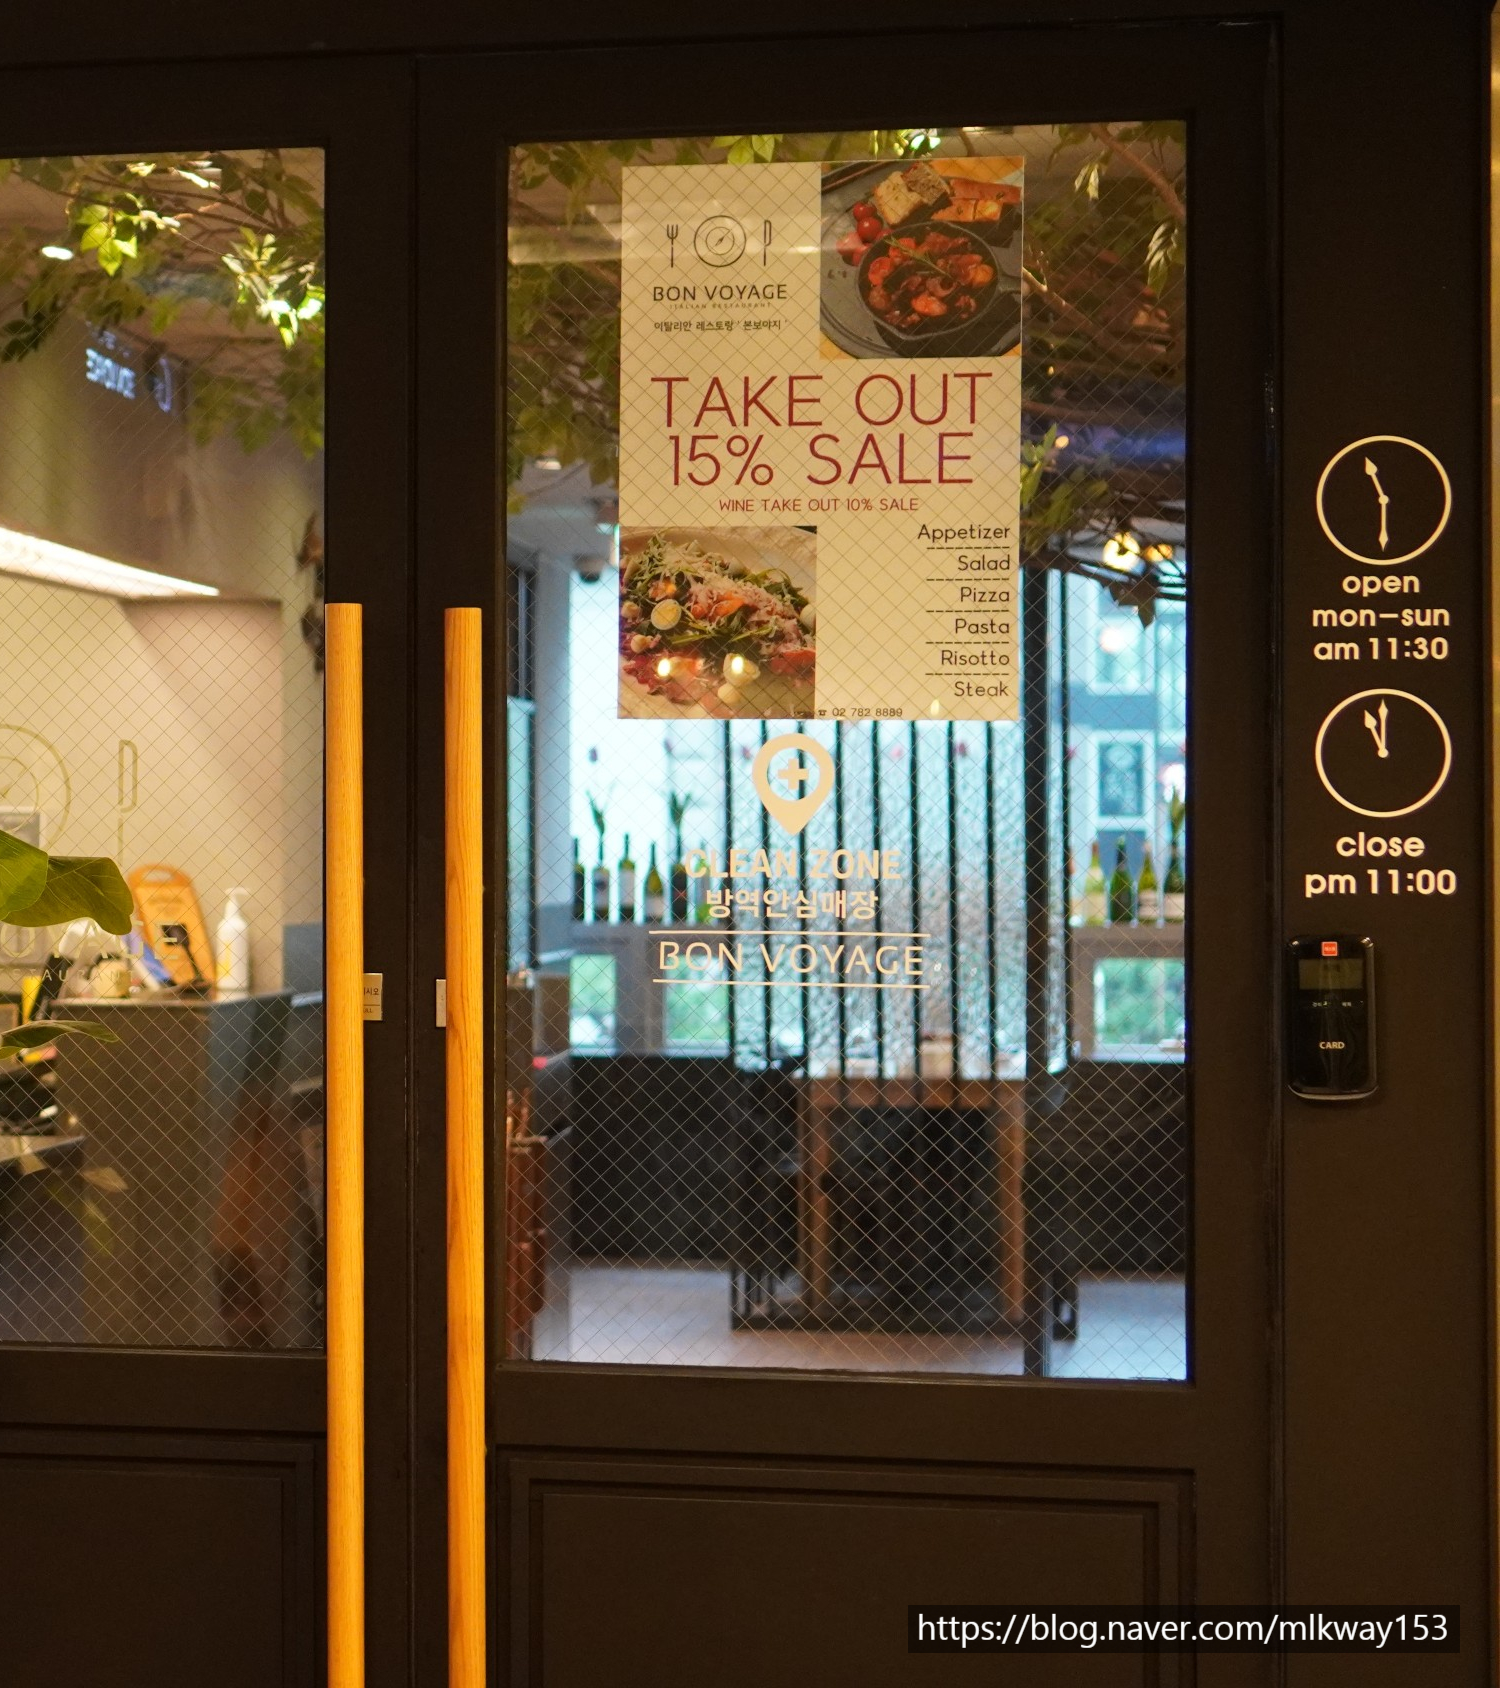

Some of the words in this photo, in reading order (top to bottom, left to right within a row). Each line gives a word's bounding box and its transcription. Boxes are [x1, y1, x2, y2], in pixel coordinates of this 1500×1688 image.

[653, 286, 696, 301] BON
[704, 284, 787, 300] VOYAGE
[654, 321, 692, 332] 이탈리안
[696, 320, 734, 332] 레스토랑
[651, 375, 823, 428] TAKE
[855, 373, 993, 426] OUT
[669, 434, 774, 486] 15%
[807, 432, 974, 486] SALE
[719, 498, 754, 512] WINE
[761, 498, 801, 512] TAKE
[808, 498, 840, 511] OUT
[846, 497, 873, 511] 10%
[879, 497, 919, 511] SALE
[917, 524, 1010, 544] Appetizer
[957, 555, 1010, 572] Salad
[960, 587, 1010, 603] Pizza
[1342, 574, 1420, 598] open
[954, 618, 1010, 635] Pasta
[941, 649, 1010, 666] Risotto
[1313, 640, 1360, 660] am
[1368, 637, 1449, 660] 11:30
[954, 681, 1009, 697] Steak
[832, 707, 846, 717] 02
[851, 707, 871, 717] 782
[1336, 832, 1425, 857] close
[684, 849, 797, 879] CLEAN
[808, 849, 901, 880] ZONE
[1305, 872, 1356, 898] pm
[1366, 869, 1457, 896] 11:00
[706, 889, 879, 919] 방역안심매장
[660, 941, 743, 971] BON
[760, 944, 924, 976] VOYAGE
[1319, 1041, 1345, 1049] CARD
